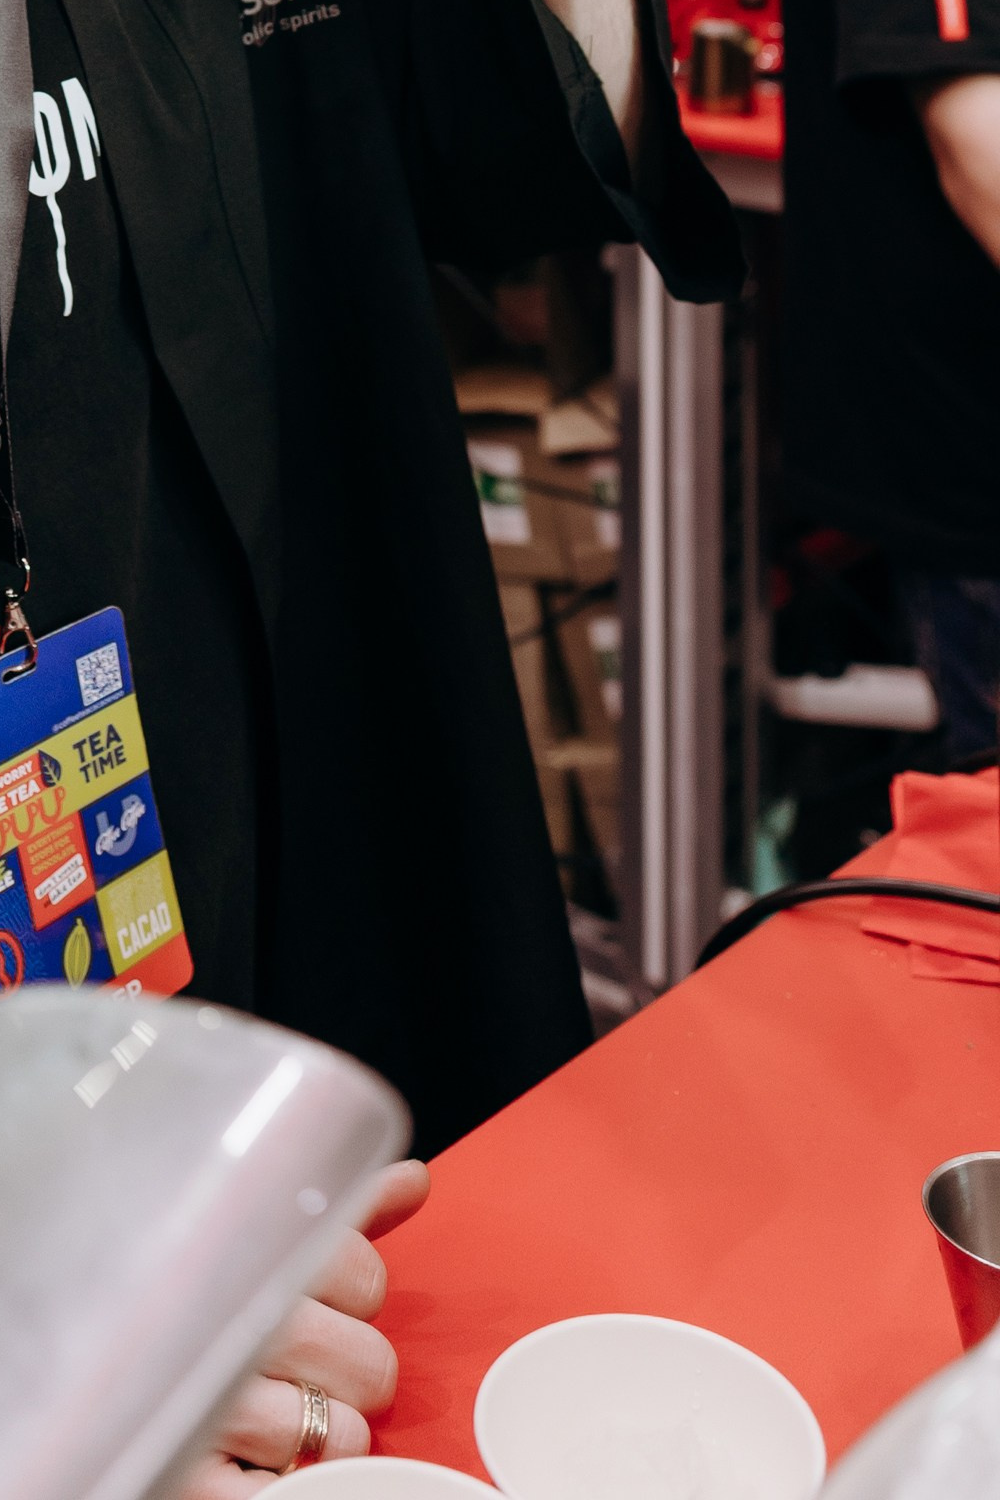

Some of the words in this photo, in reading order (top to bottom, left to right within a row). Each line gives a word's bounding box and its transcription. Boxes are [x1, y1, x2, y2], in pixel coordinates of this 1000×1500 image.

[279, 2, 341, 33] spirits
[72, 723, 122, 764] TEA
[79, 744, 127, 784] TIME
[7, 779, 41, 807] TEA
[116, 901, 173, 960] CACAO
